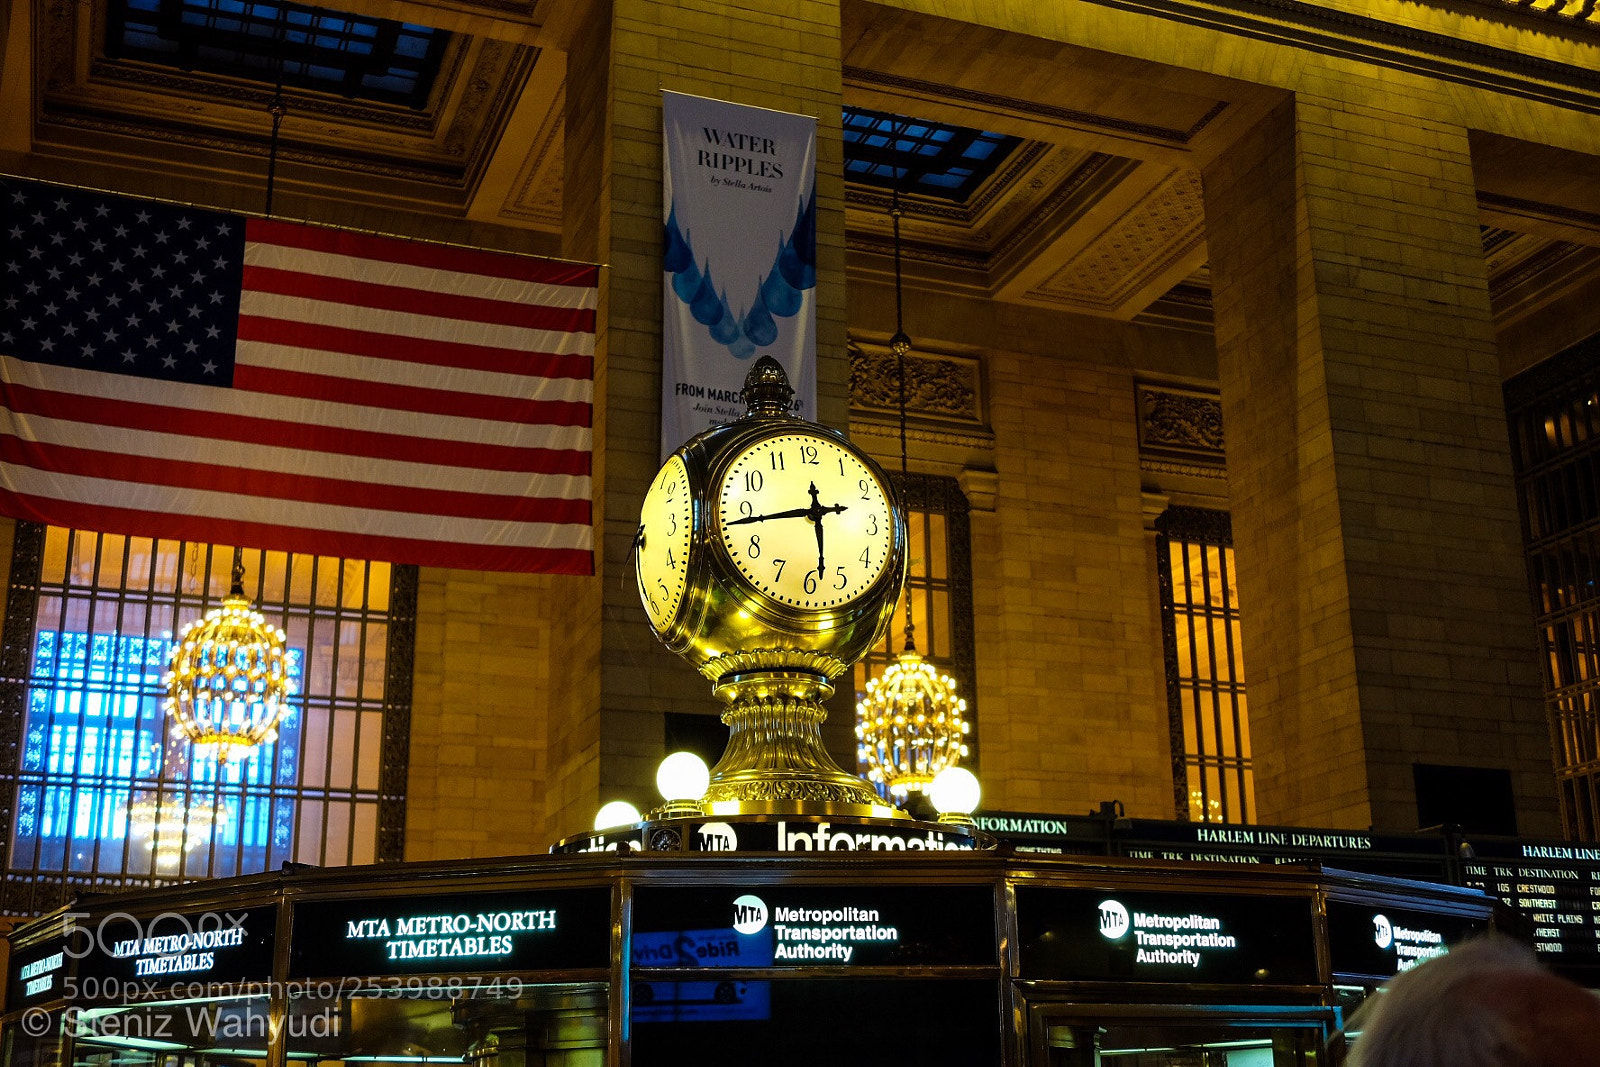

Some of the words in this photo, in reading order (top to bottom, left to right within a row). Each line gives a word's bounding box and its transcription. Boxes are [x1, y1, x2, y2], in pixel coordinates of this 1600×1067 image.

[703, 127, 776, 156] WATER
[697, 150, 784, 180] RIPPLES
[711, 175, 721, 187] by
[722, 177, 746, 189] Stella
[748, 182, 772, 193] Artois
[675, 383, 705, 398] FROM
[692, 403, 713, 413] Join
[769, 451, 785, 470] 11
[799, 446, 820, 465] 12
[838, 458, 845, 476] 1
[744, 470, 763, 492] 10
[858, 479, 871, 501] 2
[665, 481, 677, 504] 2
[739, 501, 753, 518] 9
[666, 513, 677, 536] 3
[866, 514, 878, 536] 3
[748, 535, 761, 559] 8
[858, 546, 871, 568] 4
[665, 547, 677, 570] 4
[772, 559, 786, 583] 7
[833, 567, 848, 590] 5
[657, 577, 669, 602] 5
[803, 570, 817, 595] 6
[649, 593, 660, 616] 6
[971, 817, 1068, 835] NFORMATION
[1197, 828, 1255, 845] HARLEM
[1258, 832, 1289, 846] LINE
[1291, 833, 1372, 849] DEPARTURES
[1129, 850, 1155, 860] TIME
[1161, 852, 1184, 861] TRK
[1190, 852, 1261, 865] DESTINATION
[1522, 845, 1573, 860] HARLEM
[1575, 848, 1600, 861] LINE
[1465, 866, 1488, 876] TIME
[1493, 867, 1514, 877] TRK
[1518, 868, 1580, 880] DESTINATION
[1497, 883, 1511, 893] 105
[1516, 884, 1556, 895] CRESTWOOD
[1518, 898, 1557, 909] SOUTHEAST
[347, 919, 391, 939] MTA
[395, 910, 557, 937] METRO-NORTH
[775, 907, 880, 926] Metropolitan
[1133, 912, 1221, 932] Metropolitan
[1533, 913, 1555, 923] WHITE
[1557, 914, 1584, 924] PLAINS
[113, 938, 141, 958] MTA
[142, 927, 244, 954] METRO-NORTH
[774, 925, 898, 943] Transportation
[1134, 930, 1236, 949] Transportation
[1393, 926, 1442, 944] Metropolitan
[386, 935, 513, 960] TIMETABLES
[774, 943, 853, 962] Authority
[136, 952, 215, 977] TIMETABLES
[1136, 948, 1201, 968] Authority
